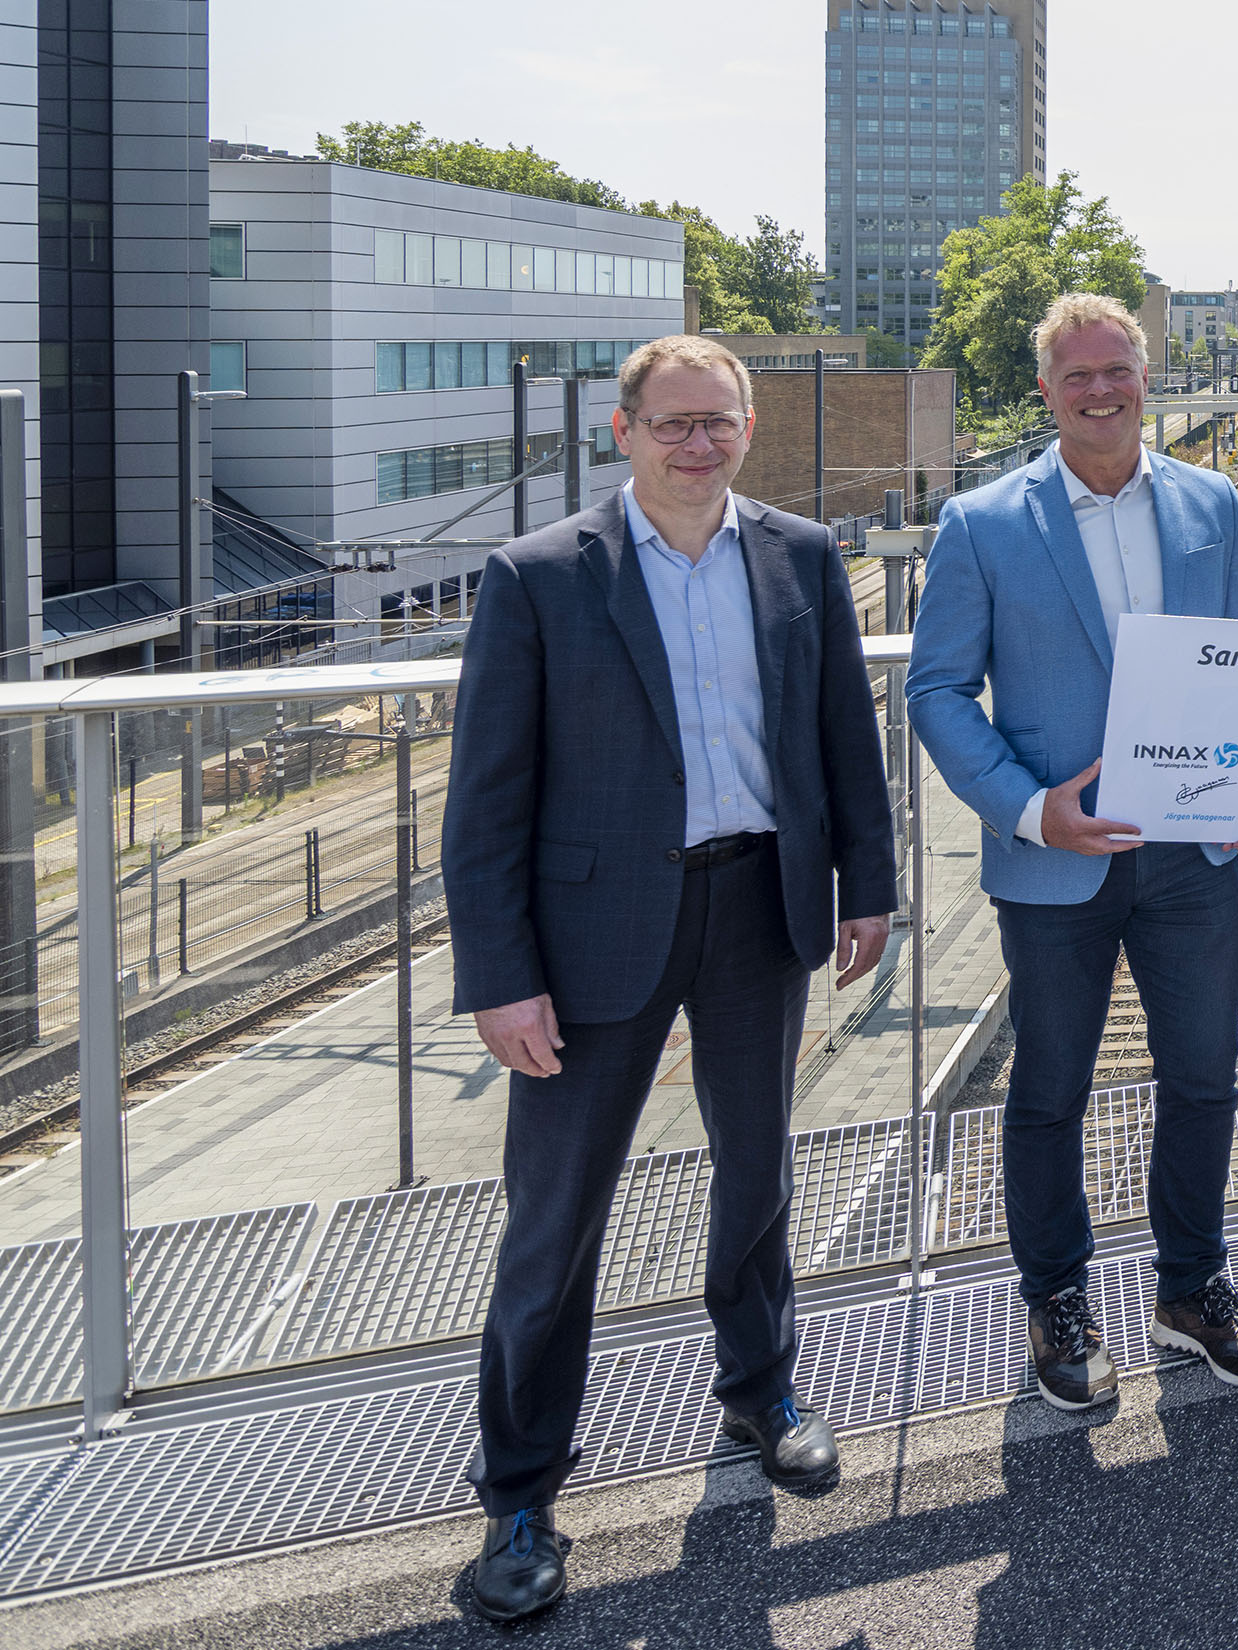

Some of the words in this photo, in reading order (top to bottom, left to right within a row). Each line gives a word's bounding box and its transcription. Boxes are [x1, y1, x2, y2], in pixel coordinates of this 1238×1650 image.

[1133, 744, 1209, 761] INNAX
[1164, 812, 1190, 822] Jörgen
[1192, 813, 1236, 823] Waagenaar
